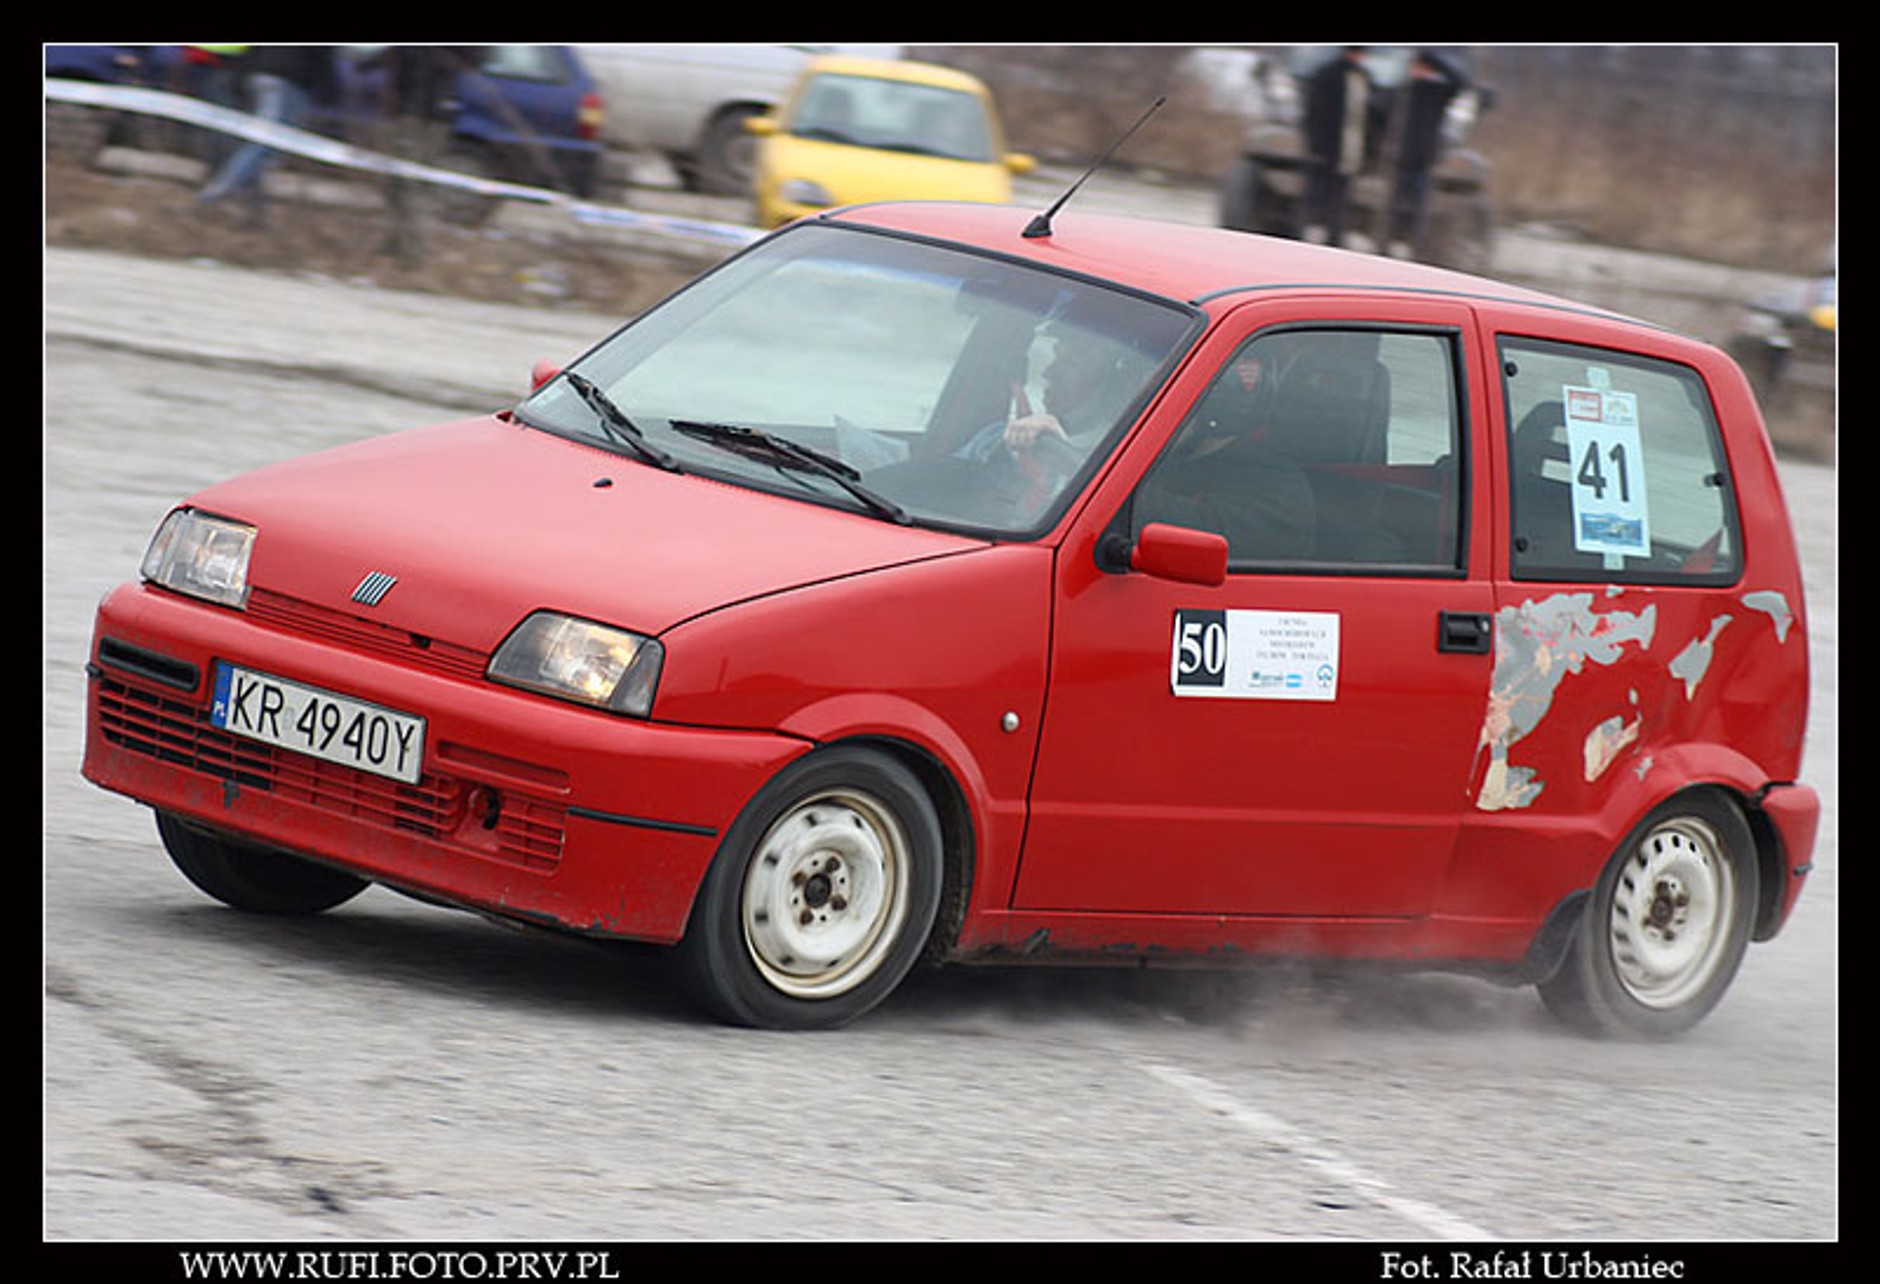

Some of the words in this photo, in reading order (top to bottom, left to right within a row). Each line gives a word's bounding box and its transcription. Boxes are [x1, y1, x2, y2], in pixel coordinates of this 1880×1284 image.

[1577, 440, 1630, 502] 41
[1179, 622, 1227, 674] 50
[232, 677, 284, 738] KR
[296, 698, 415, 772] 4940Y
